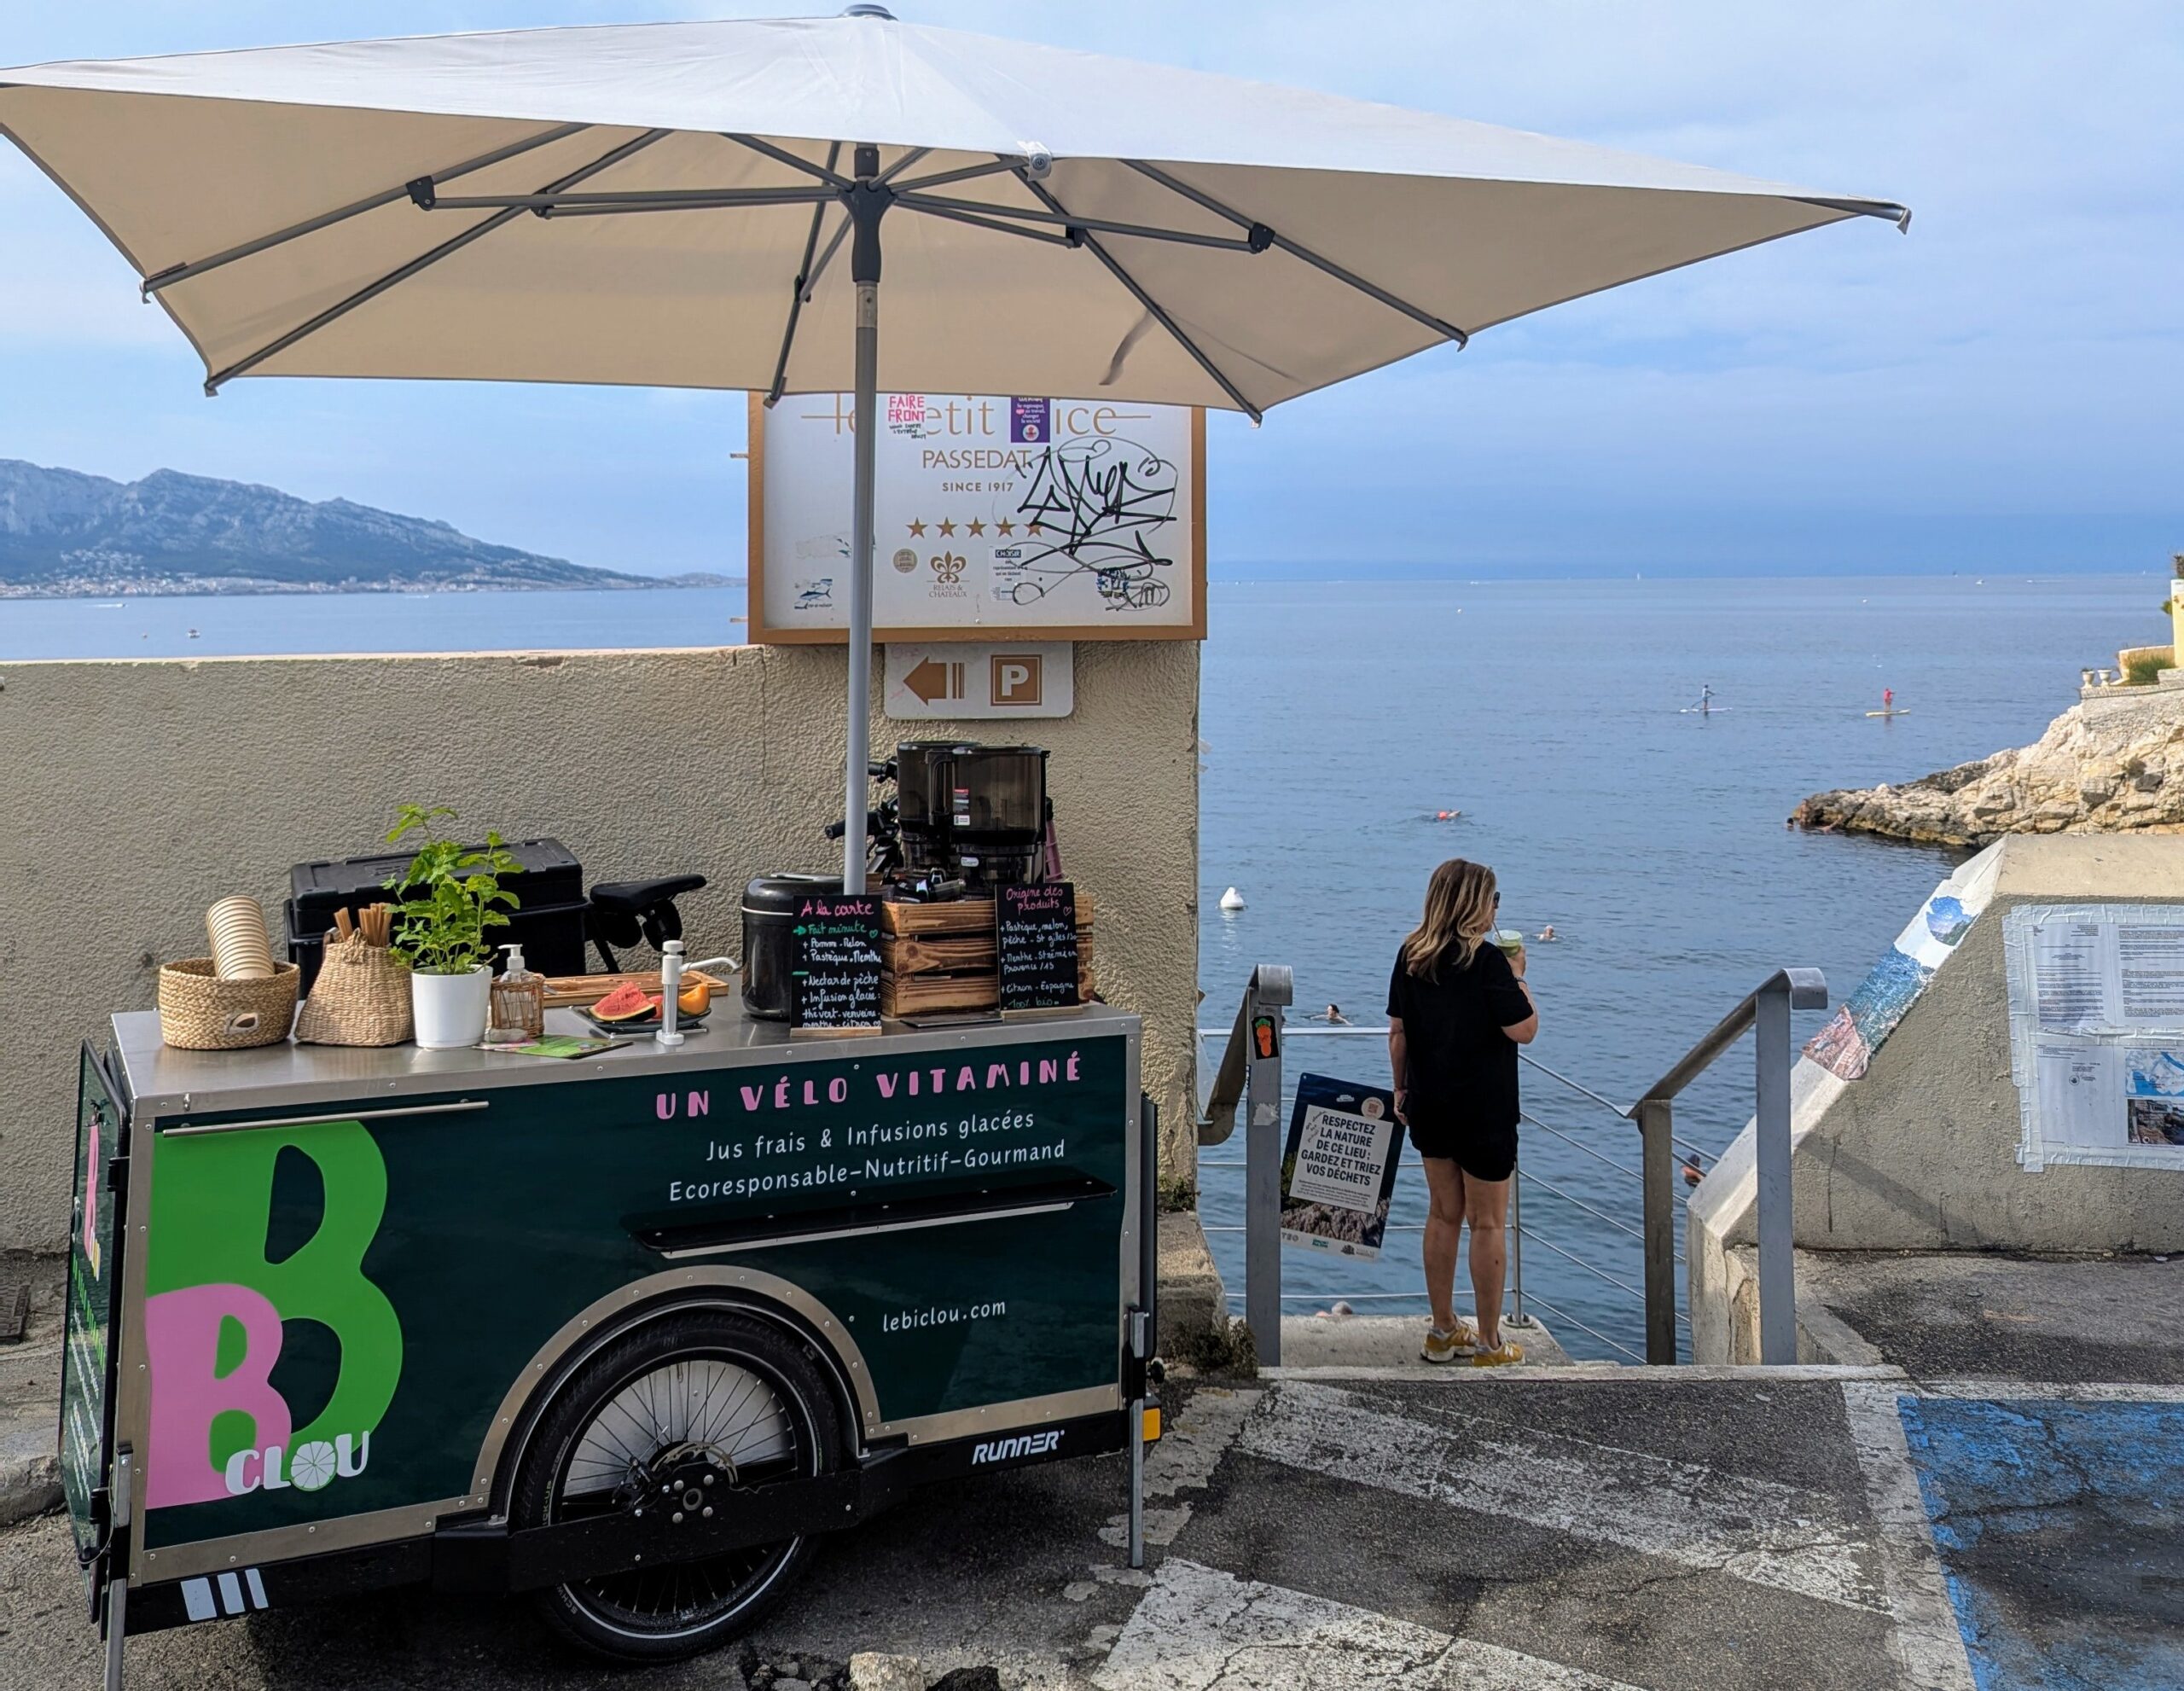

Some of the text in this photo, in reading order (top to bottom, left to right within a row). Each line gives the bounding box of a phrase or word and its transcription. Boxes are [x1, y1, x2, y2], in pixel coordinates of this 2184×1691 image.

[889, 394, 925, 409] FAIRE
[888, 409, 926, 422] FRONT
[926, 395, 996, 436] etit
[1055, 398, 1117, 435] ice
[922, 449, 1032, 469] PASSEDAT
[942, 482, 1014, 492] SINCE 1917
[1002, 665, 1030, 696] P
[1007, 884, 1064, 901] Origine des
[800, 898, 874, 917] A la carte
[1017, 897, 1060, 916] produits
[808, 919, 868, 935] Fait minute
[810, 948, 848, 966] Pastèque
[809, 970, 879, 991] Nectar de pêche
[1006, 983, 1033, 994] Citron
[810, 988, 848, 1010] Infusion
[1035, 996, 1054, 1006] bio
[802, 1007, 819, 1020] thé
[819, 1007, 839, 1019] vert
[656, 1050, 1081, 1120] UN VÉLO VITAMINÉ
[1321, 1113, 1377, 1136] RESPECTEZ
[706, 1109, 1035, 1162] Jus frais & Infusions glacées
[1320, 1126, 1333, 1140] LA
[1334, 1130, 1374, 1148] NATURE
[1316, 1139, 1367, 1160] DE CE LIEU
[1301, 1148, 1382, 1177] GARDEZ ET TRIEZ
[1306, 1163, 1371, 1187] VOS DÉCHETS
[882, 1298, 1007, 1334] lebiclou.com
[971, 1429, 1058, 1466] RUNNER
[225, 1430, 369, 1496] CLOU
[542, 1480, 553, 1526] ICK-UP
